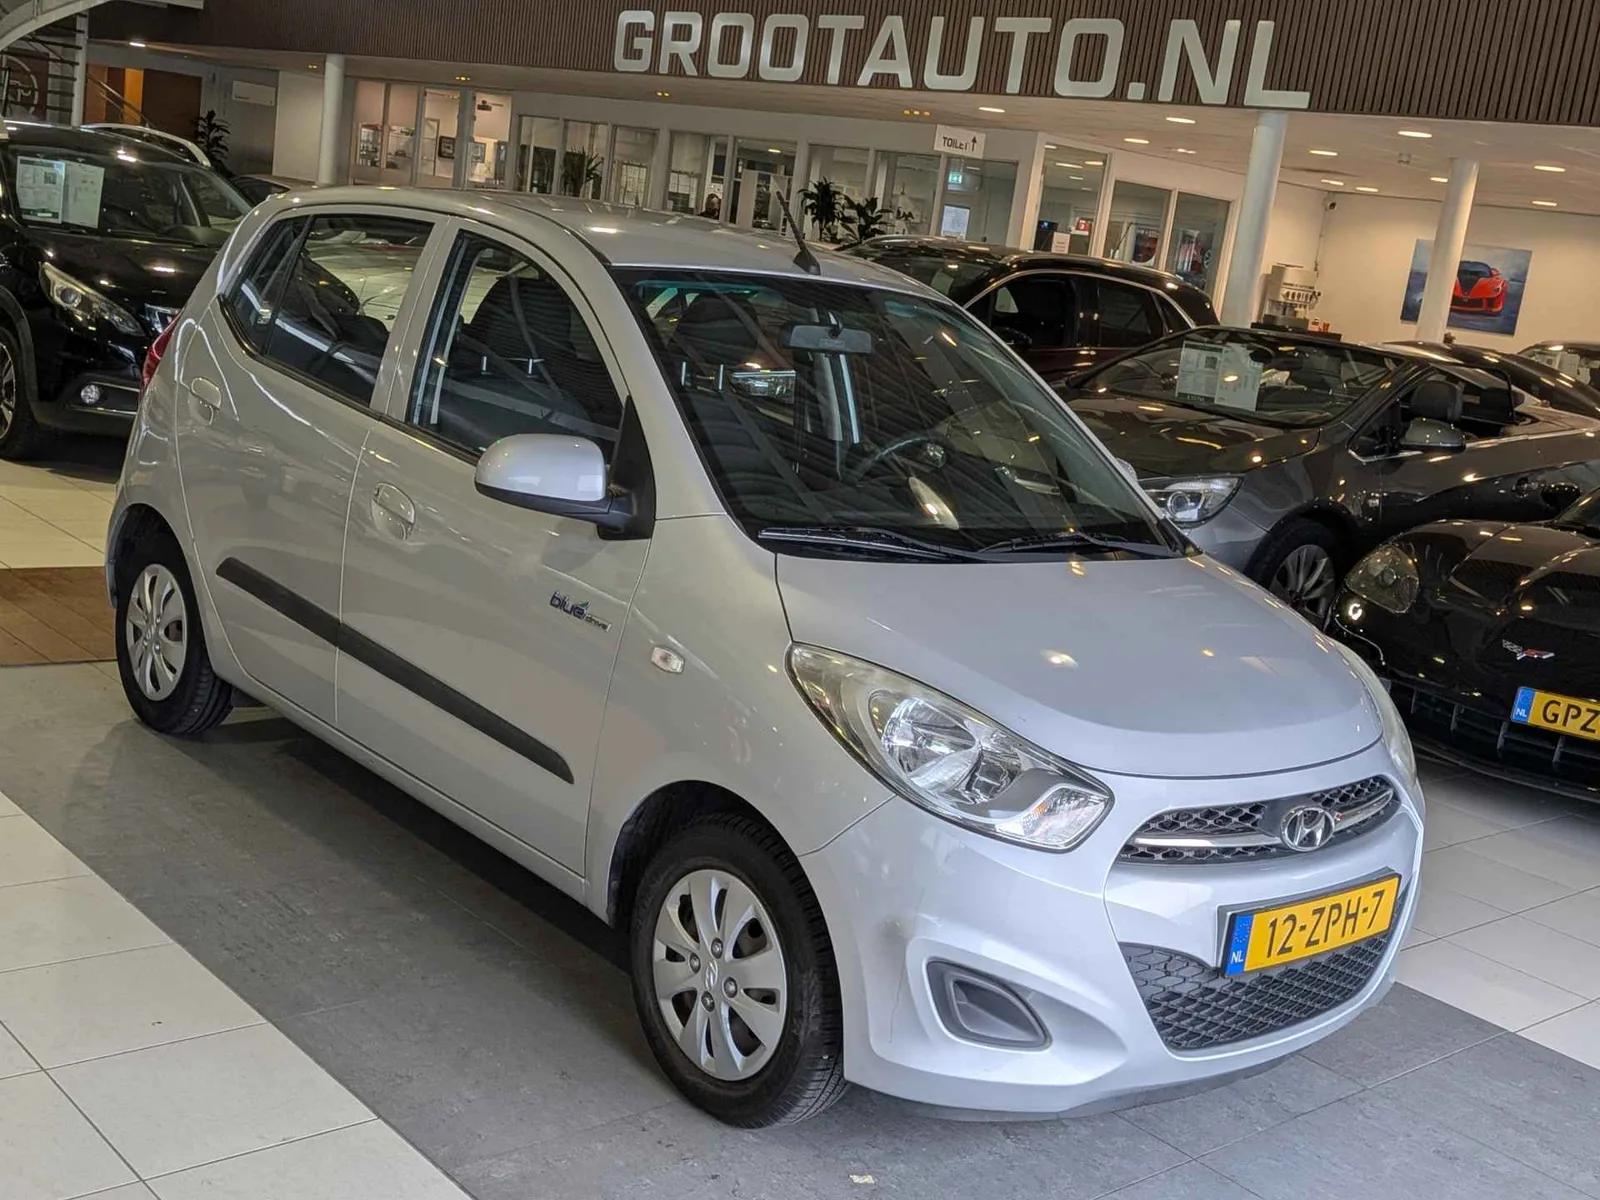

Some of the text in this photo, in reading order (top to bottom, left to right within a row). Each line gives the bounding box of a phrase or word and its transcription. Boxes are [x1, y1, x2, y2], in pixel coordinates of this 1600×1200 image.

[614, 10, 1310, 108] GROOTAUTO.NL
[550, 591, 587, 620] blue
[1515, 699, 1600, 734] NL GPZ
[1230, 889, 1385, 964] NL 12-ZPH-7
